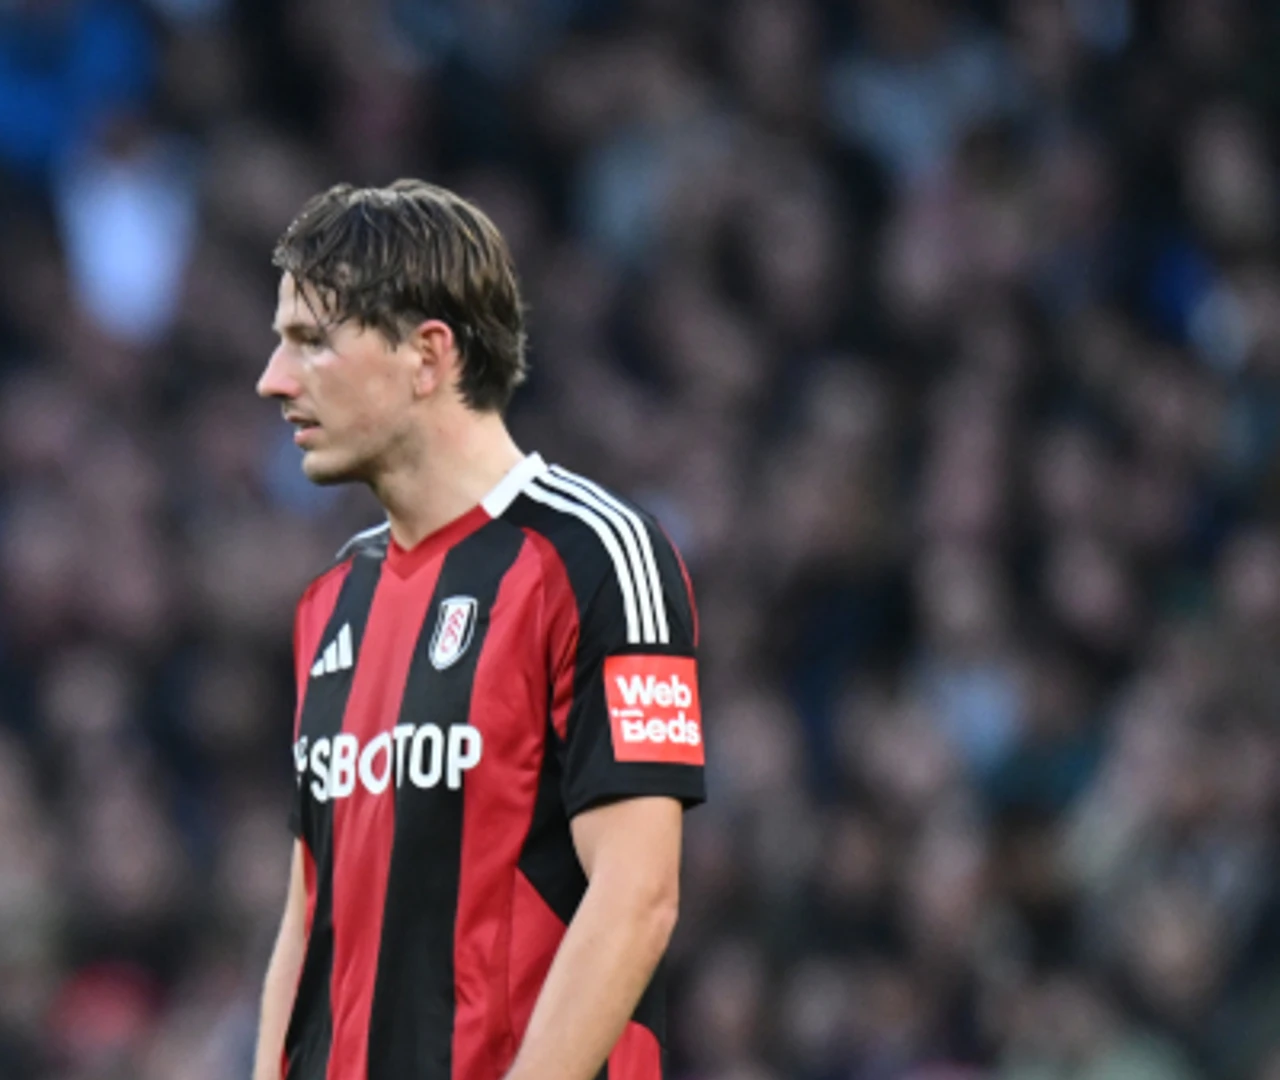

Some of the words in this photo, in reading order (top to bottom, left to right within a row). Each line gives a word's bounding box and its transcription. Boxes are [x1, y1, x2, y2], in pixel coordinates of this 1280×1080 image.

[615, 673, 692, 708] Web
[621, 710, 701, 746] Beds
[310, 722, 483, 803] SBOTOP
